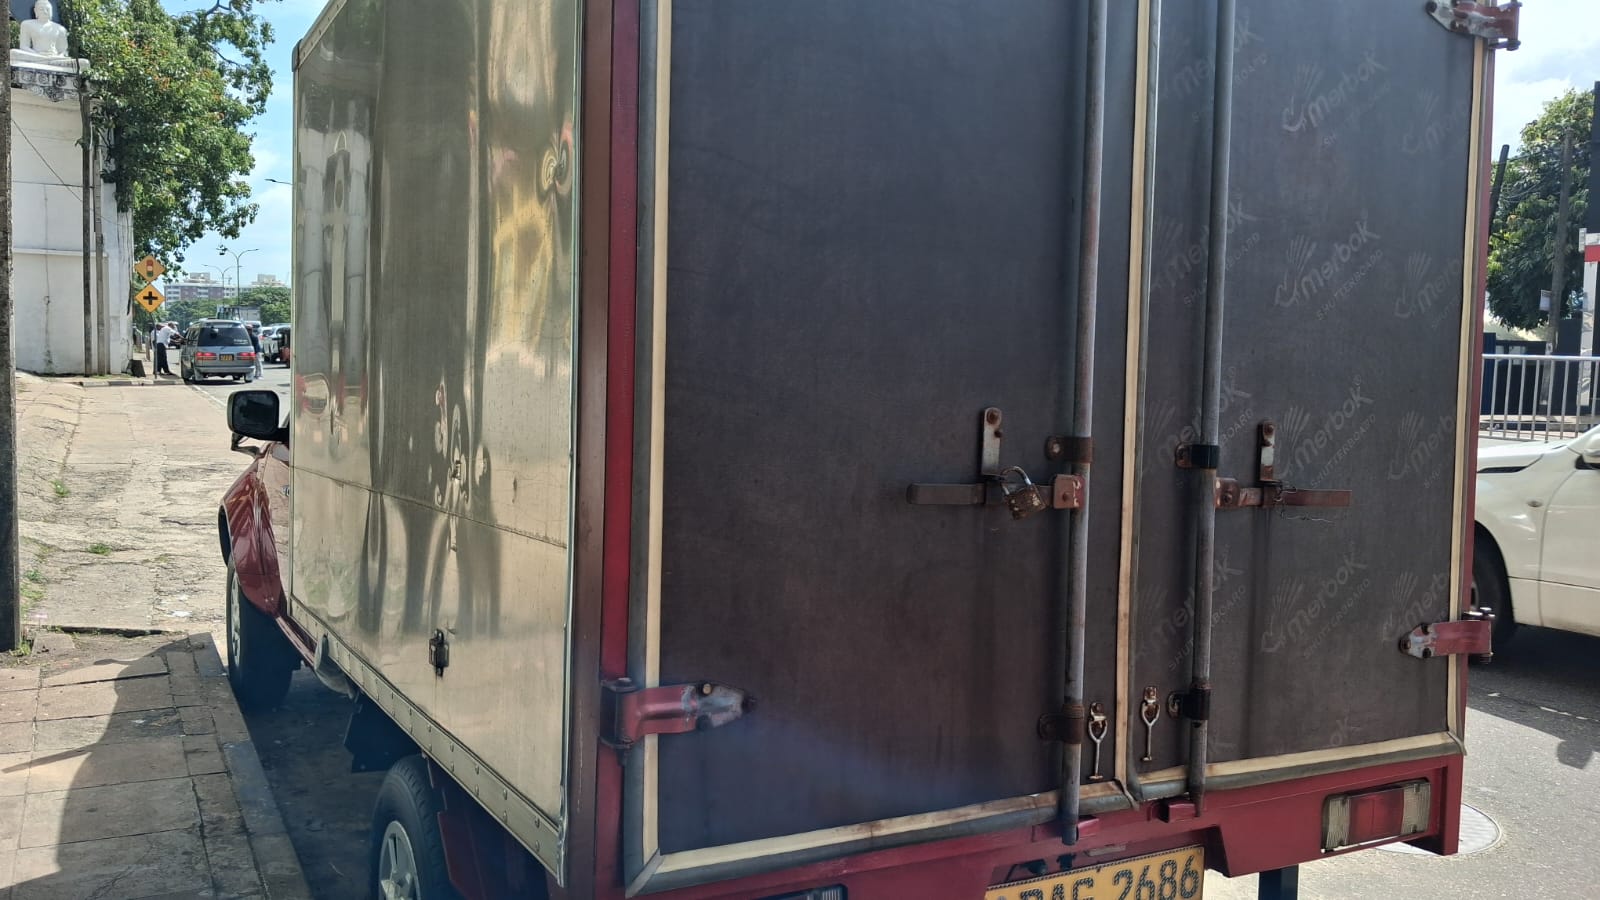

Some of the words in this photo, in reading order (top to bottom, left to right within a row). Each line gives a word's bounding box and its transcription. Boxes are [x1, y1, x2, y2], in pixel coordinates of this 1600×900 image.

[1307, 49, 1387, 128] merbok
[1167, 199, 1257, 288] merok
[1301, 220, 1380, 300] merbok
[1157, 378, 1252, 467] merok
[1295, 386, 1375, 471] merbok
[1310, 414, 1375, 488] SHUTTERBOARD
[1152, 556, 1245, 644] merok
[1287, 553, 1368, 642] merbok
[1112, 855, 1199, 900] 2686
